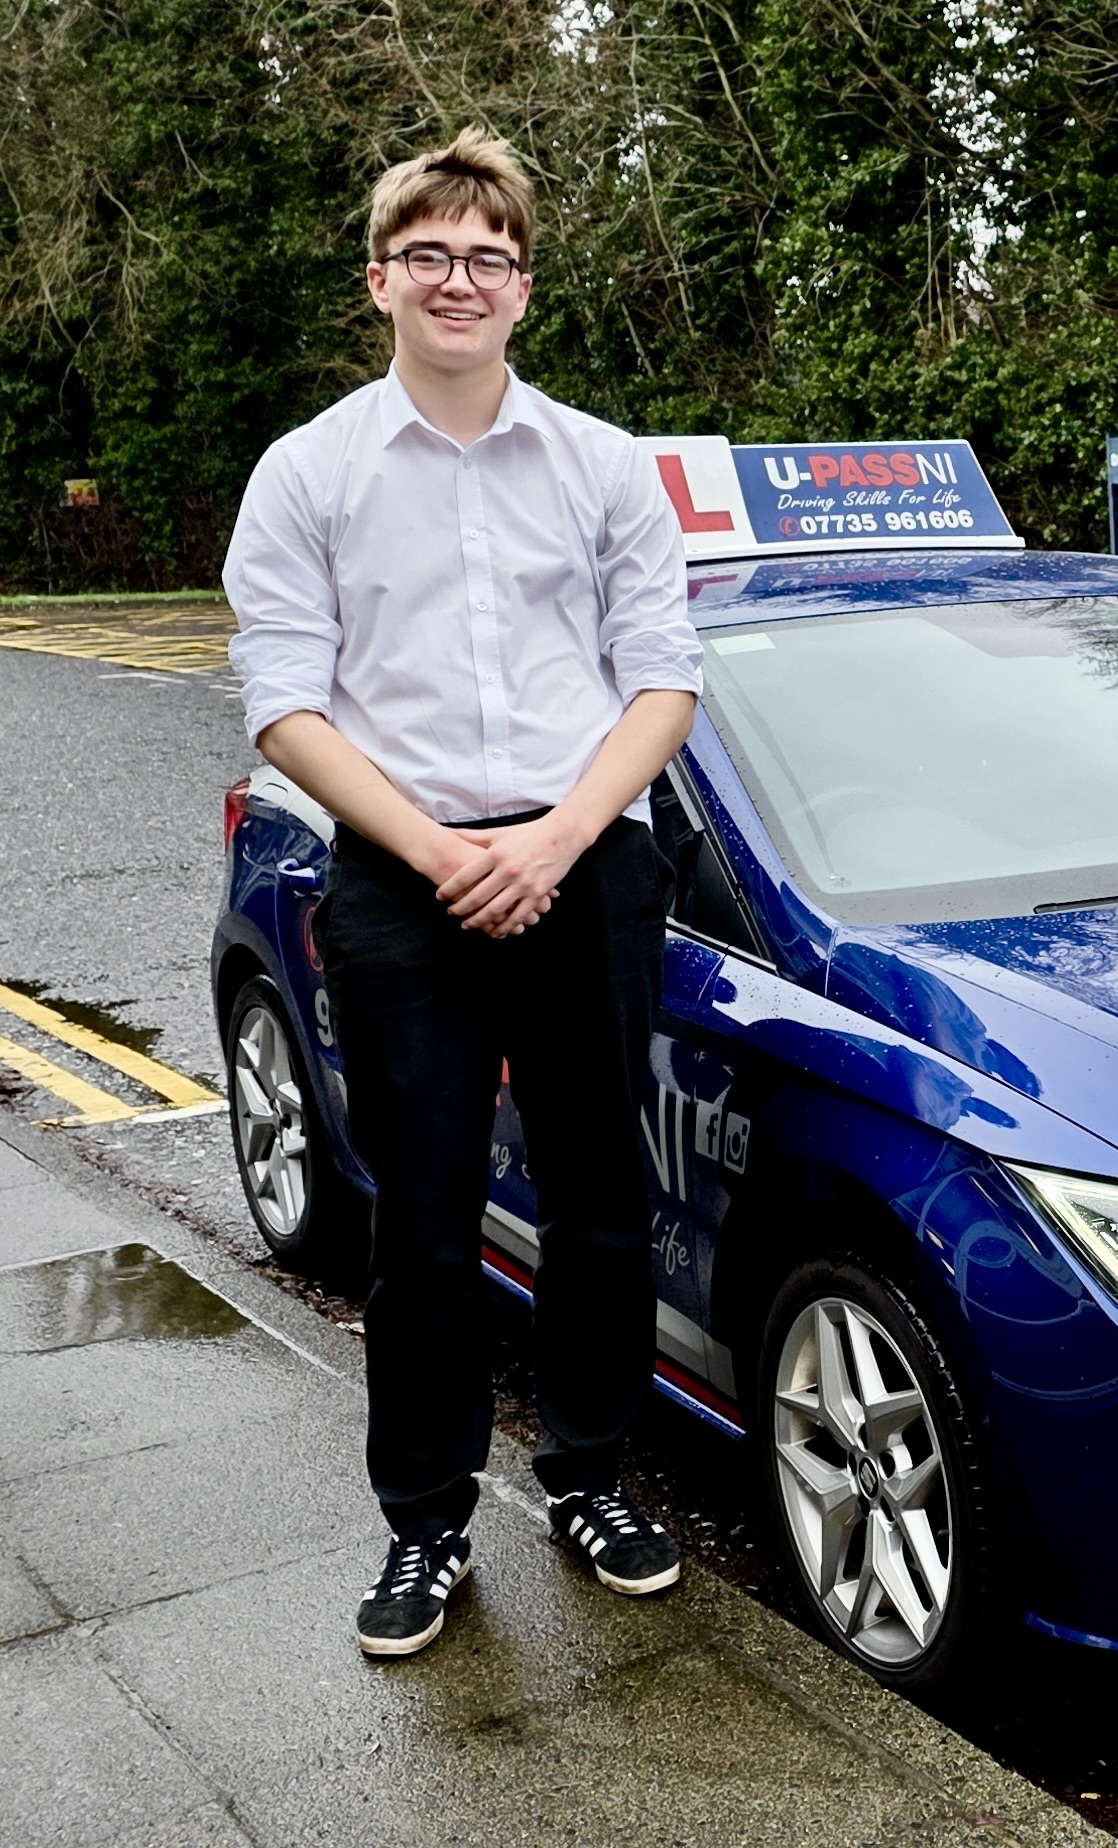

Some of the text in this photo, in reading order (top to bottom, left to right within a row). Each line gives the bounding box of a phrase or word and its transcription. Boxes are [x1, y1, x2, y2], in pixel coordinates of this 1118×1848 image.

[656, 454, 735, 533] L
[777, 488, 961, 511] Driving Skills For Life
[800, 509, 974, 535] 07735 961606
[651, 1210, 690, 1276] Life
